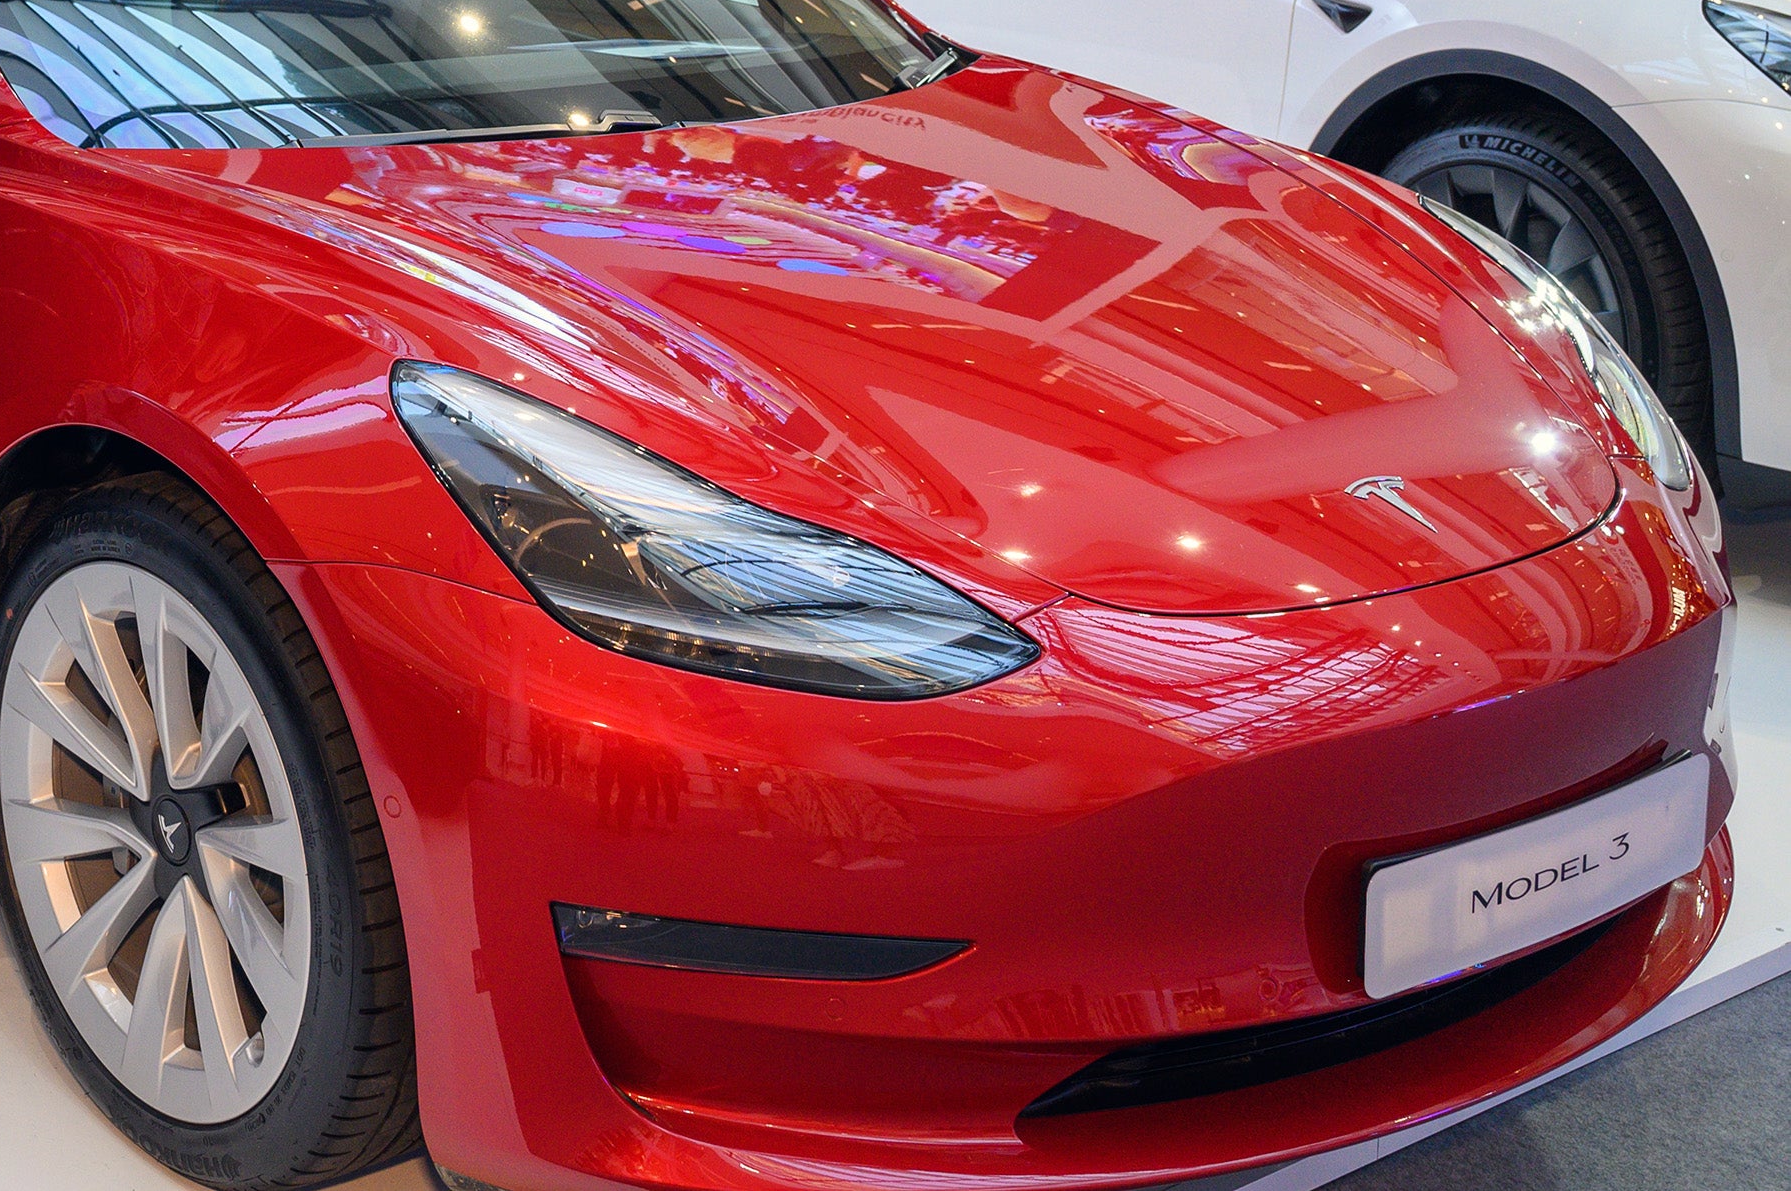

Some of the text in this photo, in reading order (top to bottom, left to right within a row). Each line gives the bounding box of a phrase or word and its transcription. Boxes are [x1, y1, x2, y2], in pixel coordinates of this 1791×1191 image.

[1483, 136, 1581, 188] MICHELIN
[1471, 832, 1630, 914] MODEL 3
